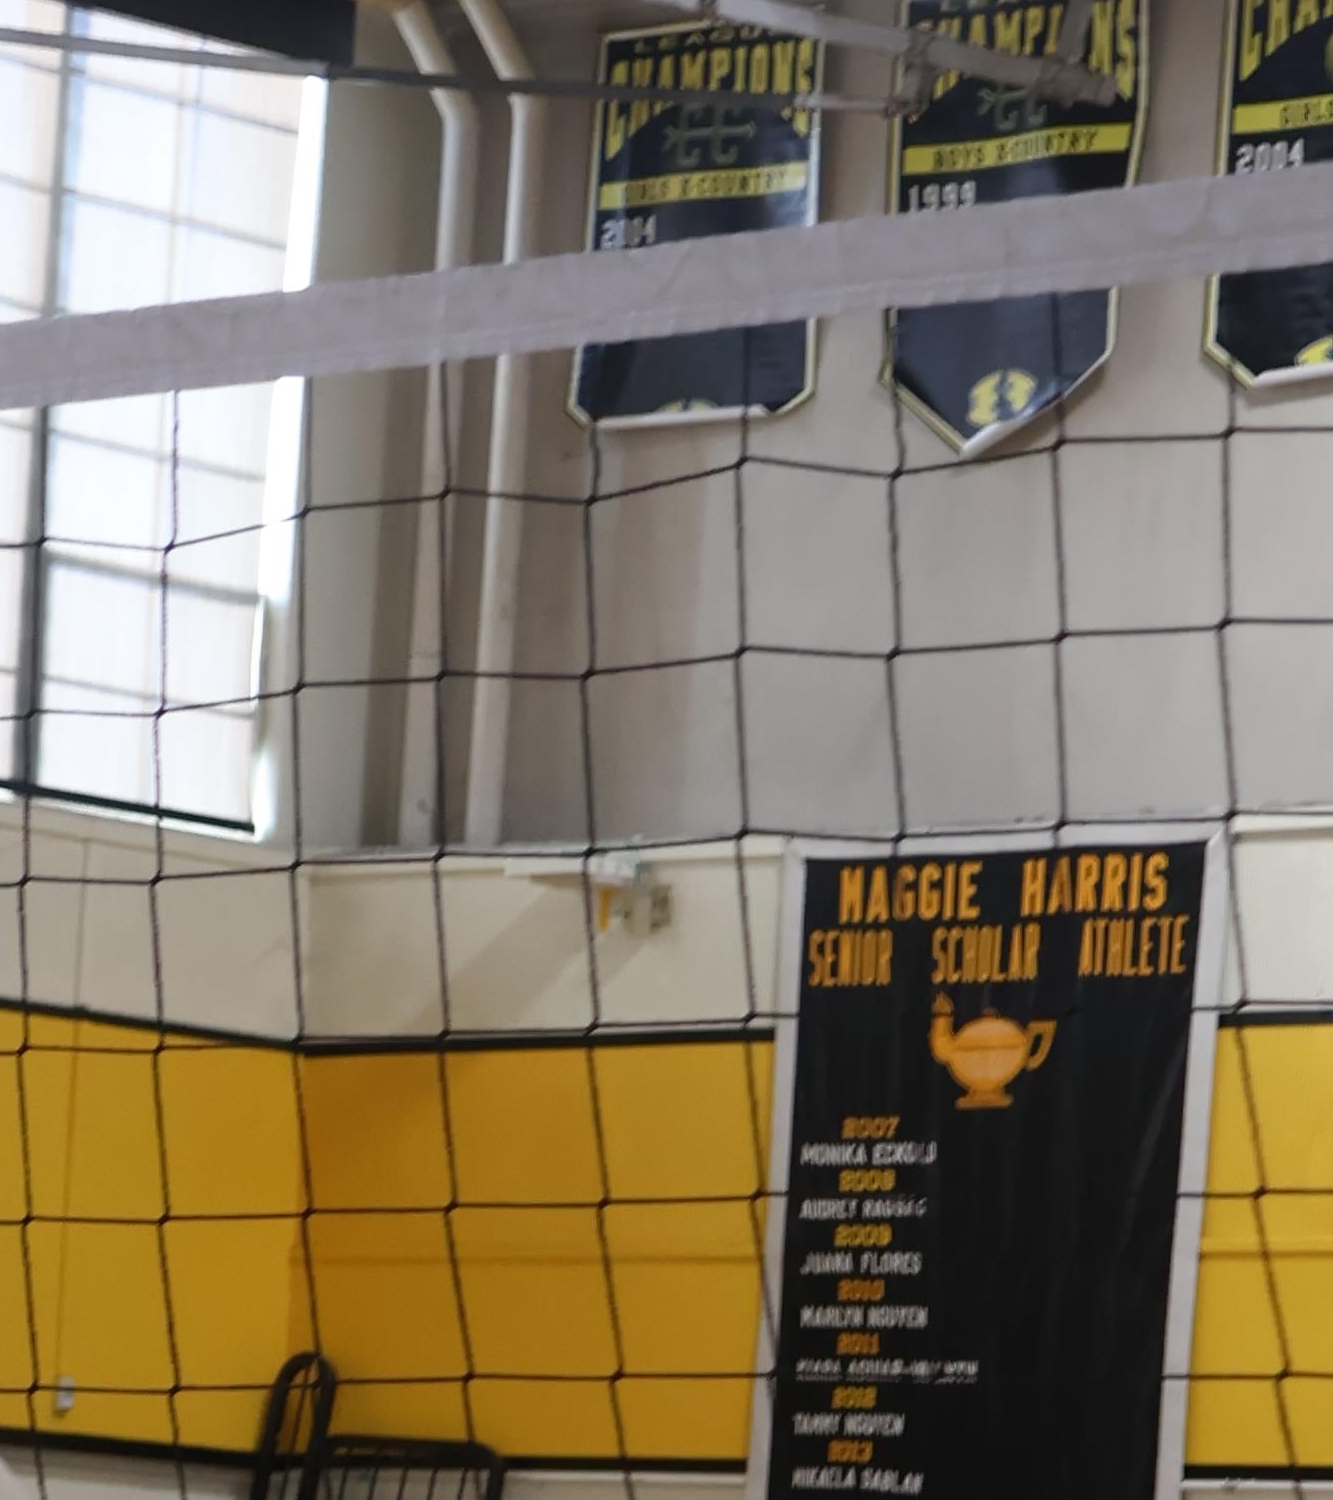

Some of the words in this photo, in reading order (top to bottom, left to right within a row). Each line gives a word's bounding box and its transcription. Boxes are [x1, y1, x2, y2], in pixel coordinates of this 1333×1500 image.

[838, 860, 983, 924] MAGGIE
[1020, 852, 1170, 917] HARRIS
[808, 928, 893, 987] SENIOR
[932, 922, 1041, 985] SCHOLAR
[1078, 915, 1190, 977] ATHLETE
[860, 1252, 922, 1275] FLORES
